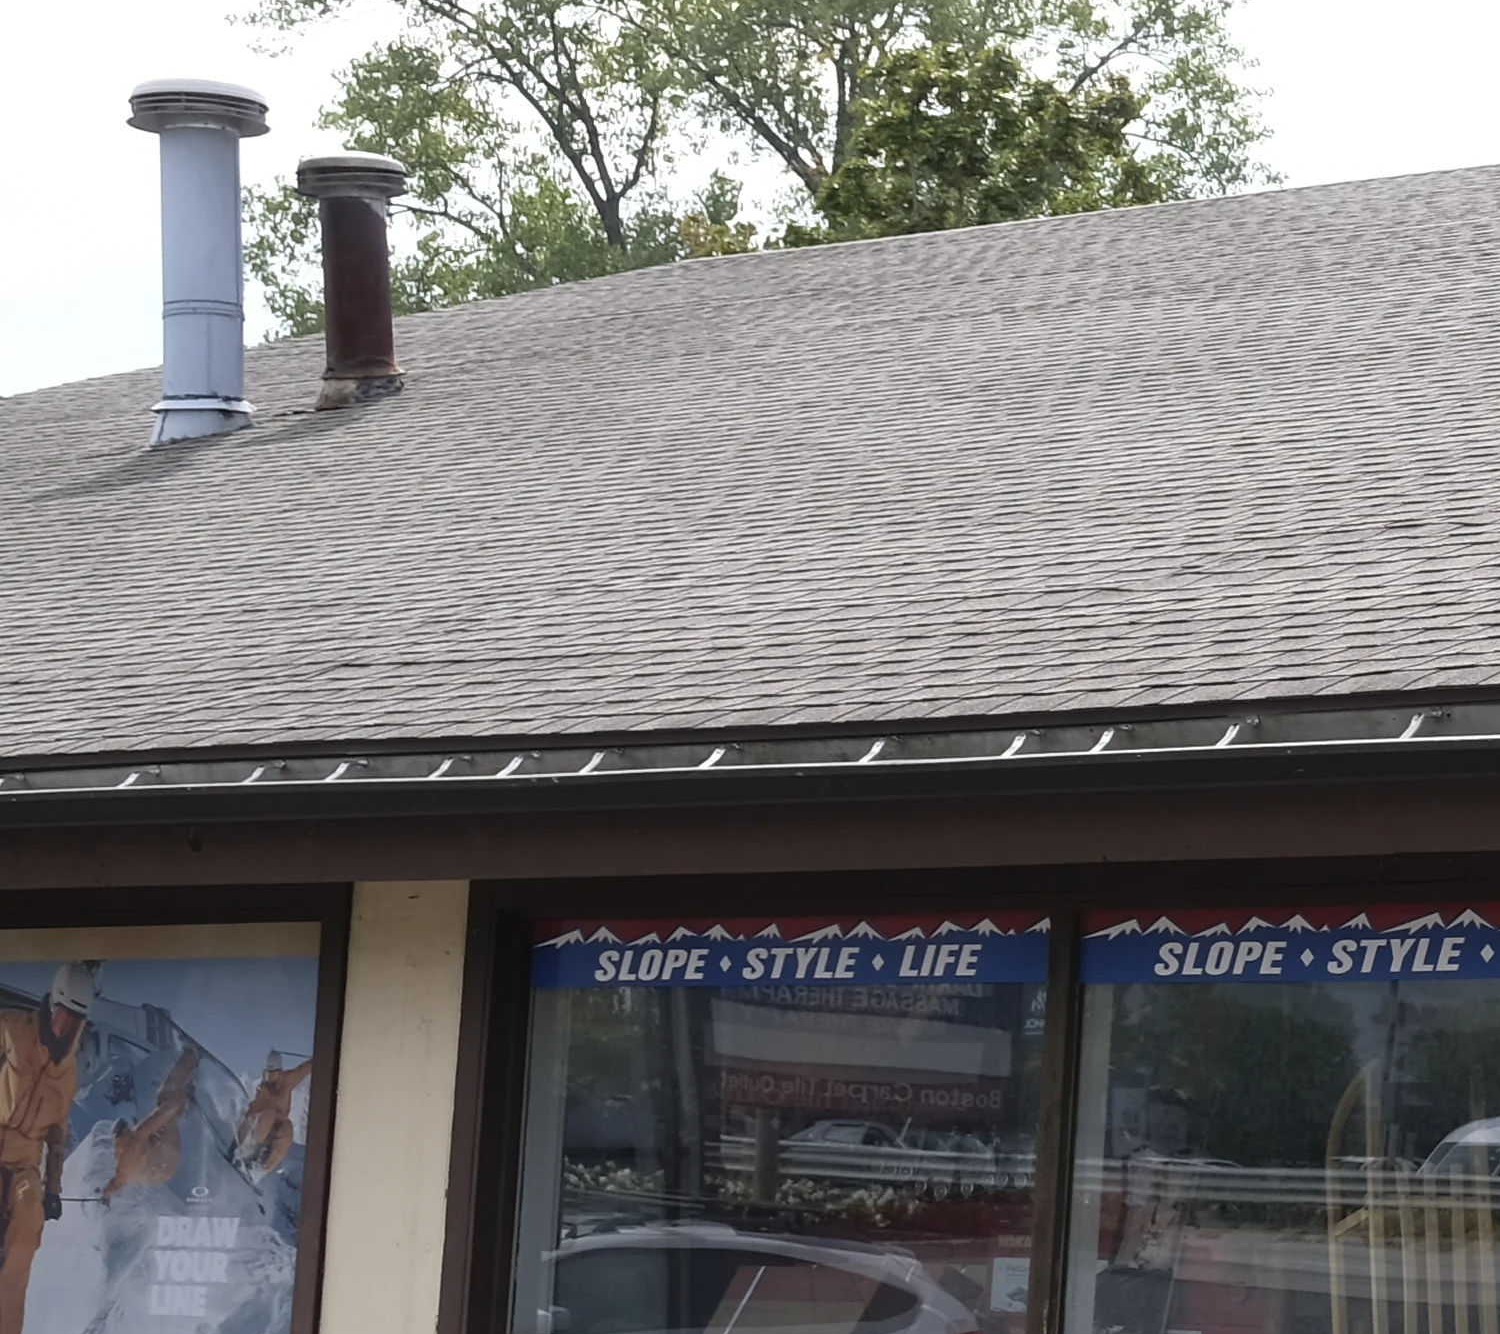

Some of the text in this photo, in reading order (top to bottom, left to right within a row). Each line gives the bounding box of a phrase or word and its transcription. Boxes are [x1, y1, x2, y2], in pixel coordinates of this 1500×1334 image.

[595, 942, 982, 983] SLOPE STYLE LIFE
[1154, 940, 1285, 977] SLOPE
[1327, 936, 1466, 975] STYLE
[155, 1215, 242, 1249] DRAW
[153, 1250, 229, 1283] YOUR
[149, 1284, 208, 1317] LINE
